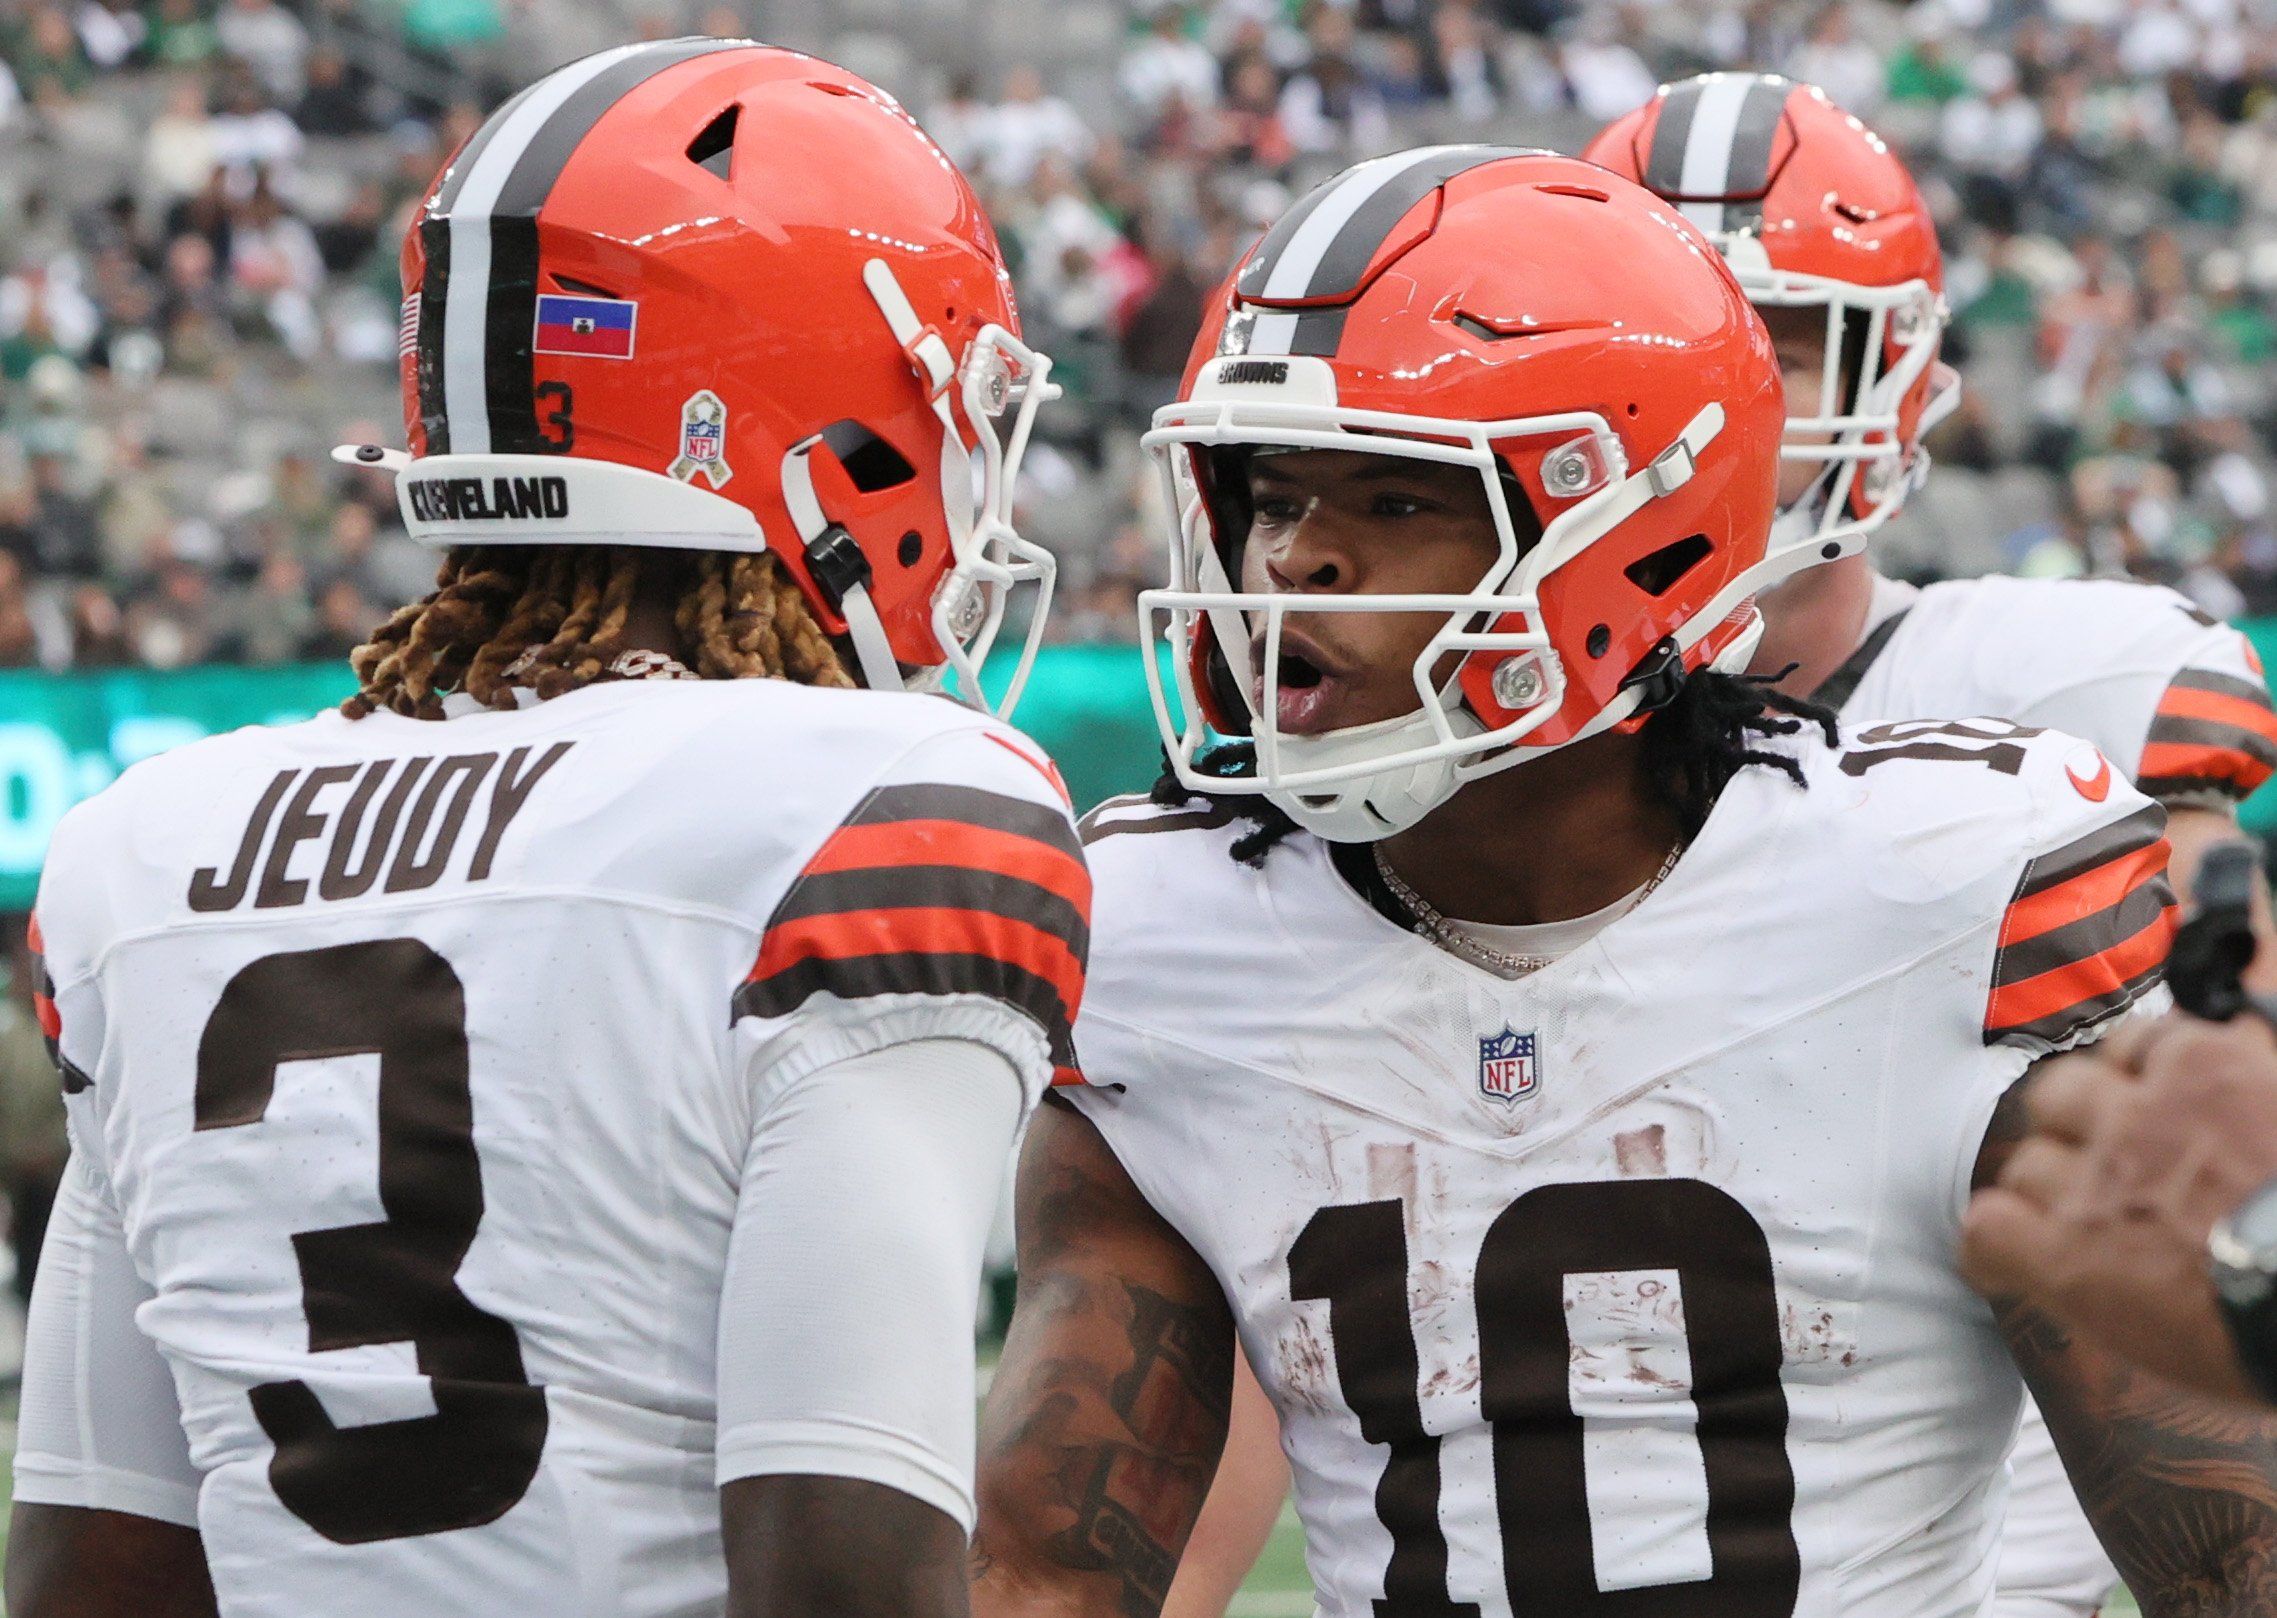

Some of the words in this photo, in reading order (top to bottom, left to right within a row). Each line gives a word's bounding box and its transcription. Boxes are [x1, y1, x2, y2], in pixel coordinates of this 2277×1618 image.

[535, 380, 574, 453] 3
[688, 437, 718, 459] NFL
[407, 476, 568, 521] CLEVELAND
[188, 741, 576, 911] JEUDY
[1486, 1059, 1532, 1094] NFL
[193, 936, 548, 1545] 3
[1286, 1176, 1801, 1618] 10
